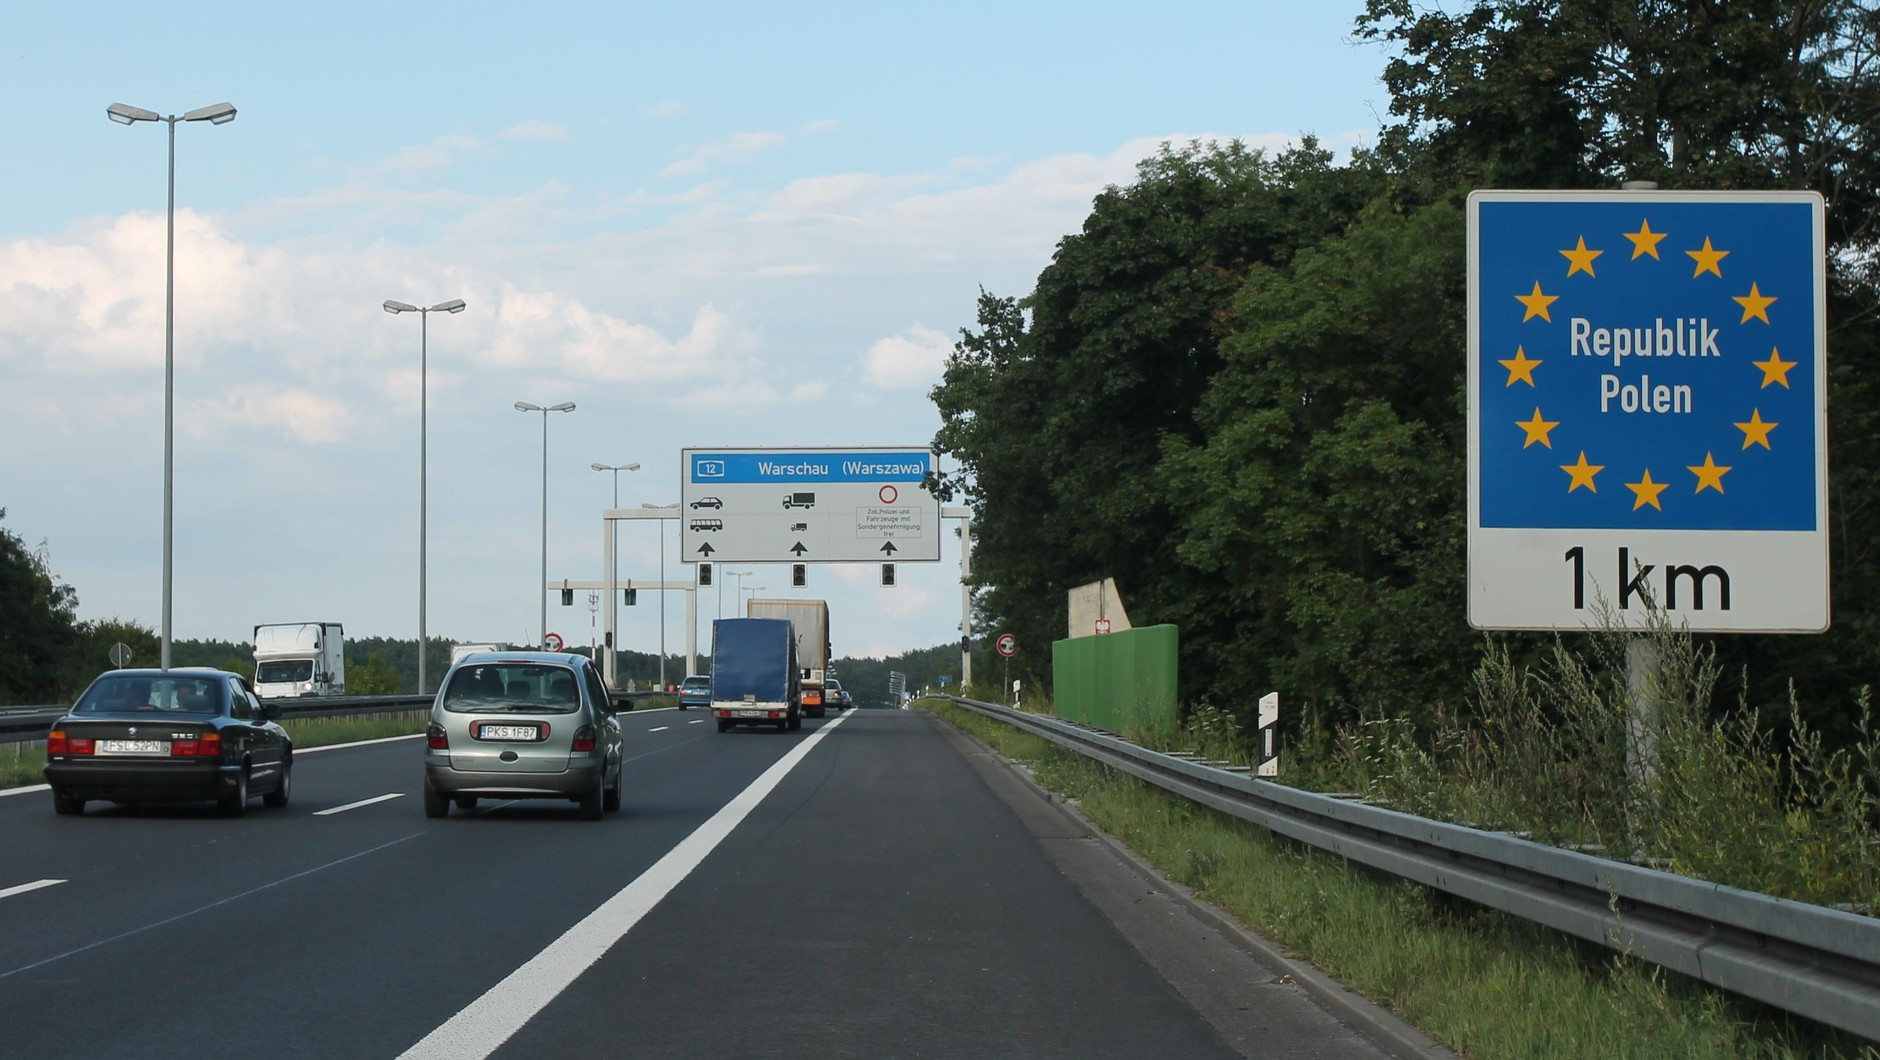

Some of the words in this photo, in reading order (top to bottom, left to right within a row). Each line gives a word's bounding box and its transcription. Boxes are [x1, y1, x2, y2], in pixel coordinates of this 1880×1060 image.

[1569, 317, 1721, 367] Republik
[1600, 374, 1692, 413] Polen
[705, 464, 716, 474] 12
[758, 461, 829, 476] Warschau
[842, 461, 924, 476] (Warszawa)
[866, 515, 899, 523] Fahrzeuge
[857, 523, 921, 531] Sondergenehmigung
[1564, 546, 1584, 610] 1
[1618, 546, 1731, 611] km
[487, 727, 509, 737] PKS
[512, 727, 535, 738] 1F87
